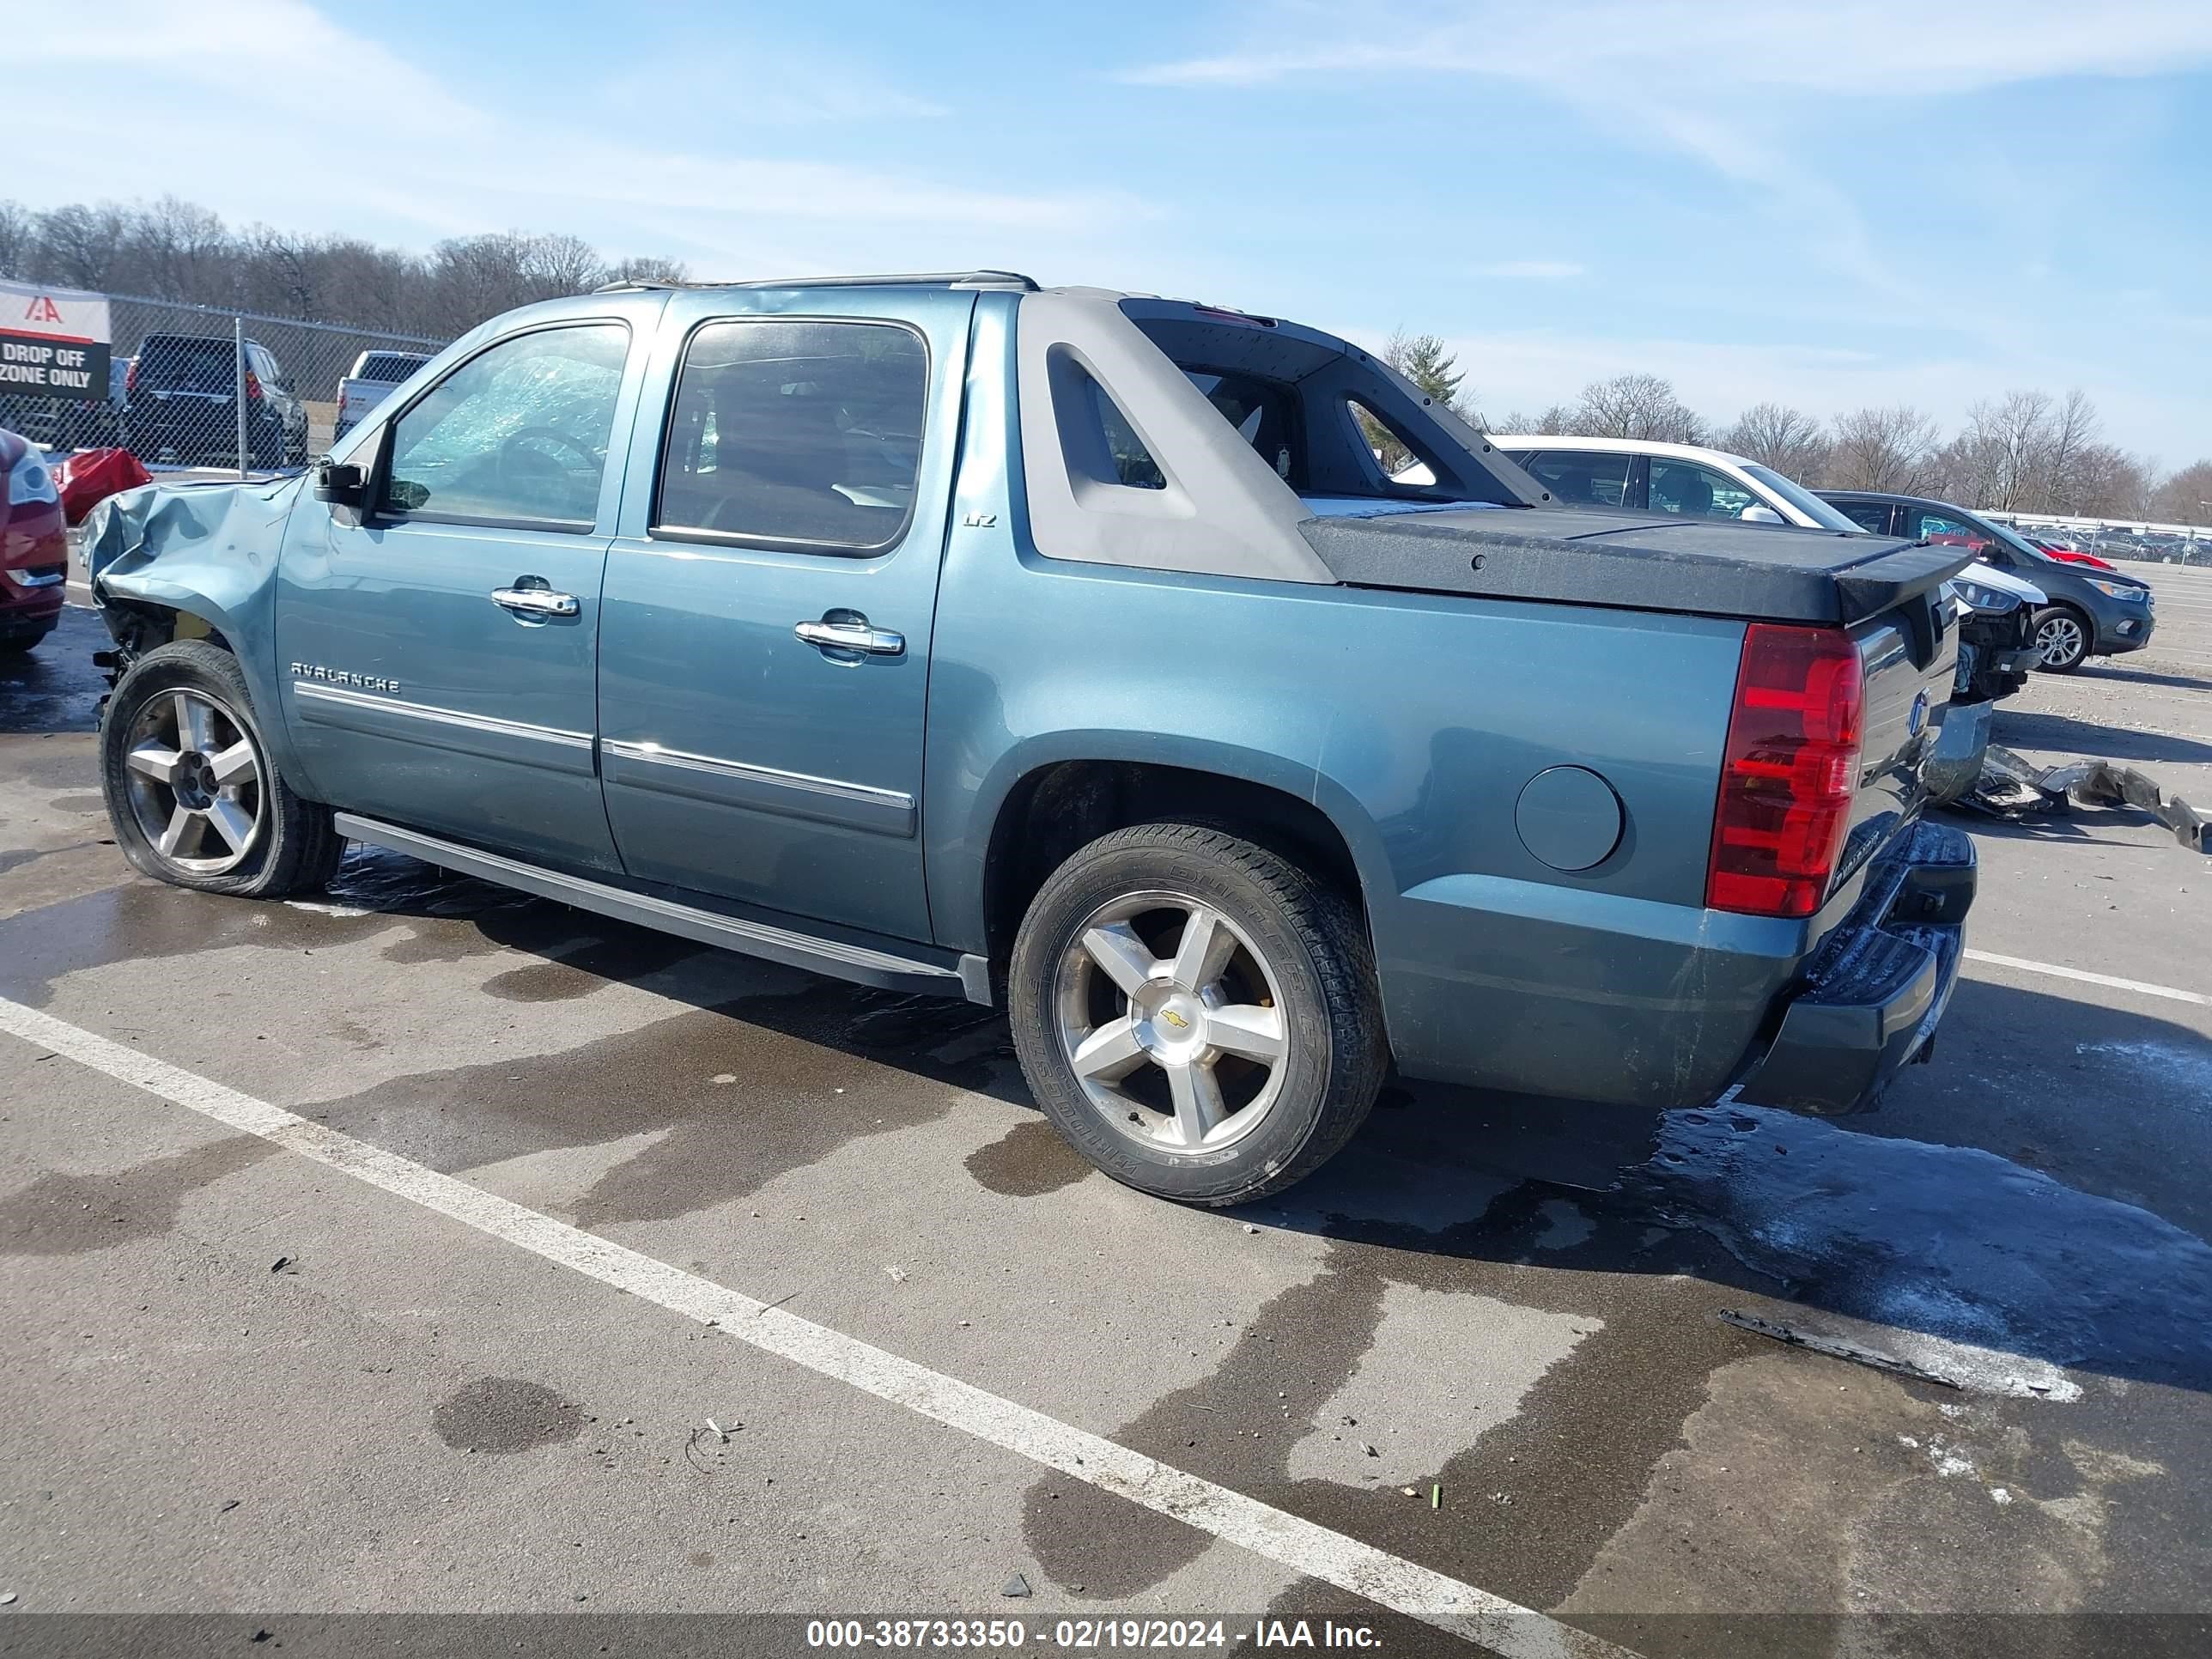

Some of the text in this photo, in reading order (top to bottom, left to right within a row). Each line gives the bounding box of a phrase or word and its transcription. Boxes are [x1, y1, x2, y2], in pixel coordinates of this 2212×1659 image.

[3, 343, 86, 368] DROP OFF
[0, 364, 92, 388] ZONE ONLY
[290, 662, 400, 694] AVALANCHE
